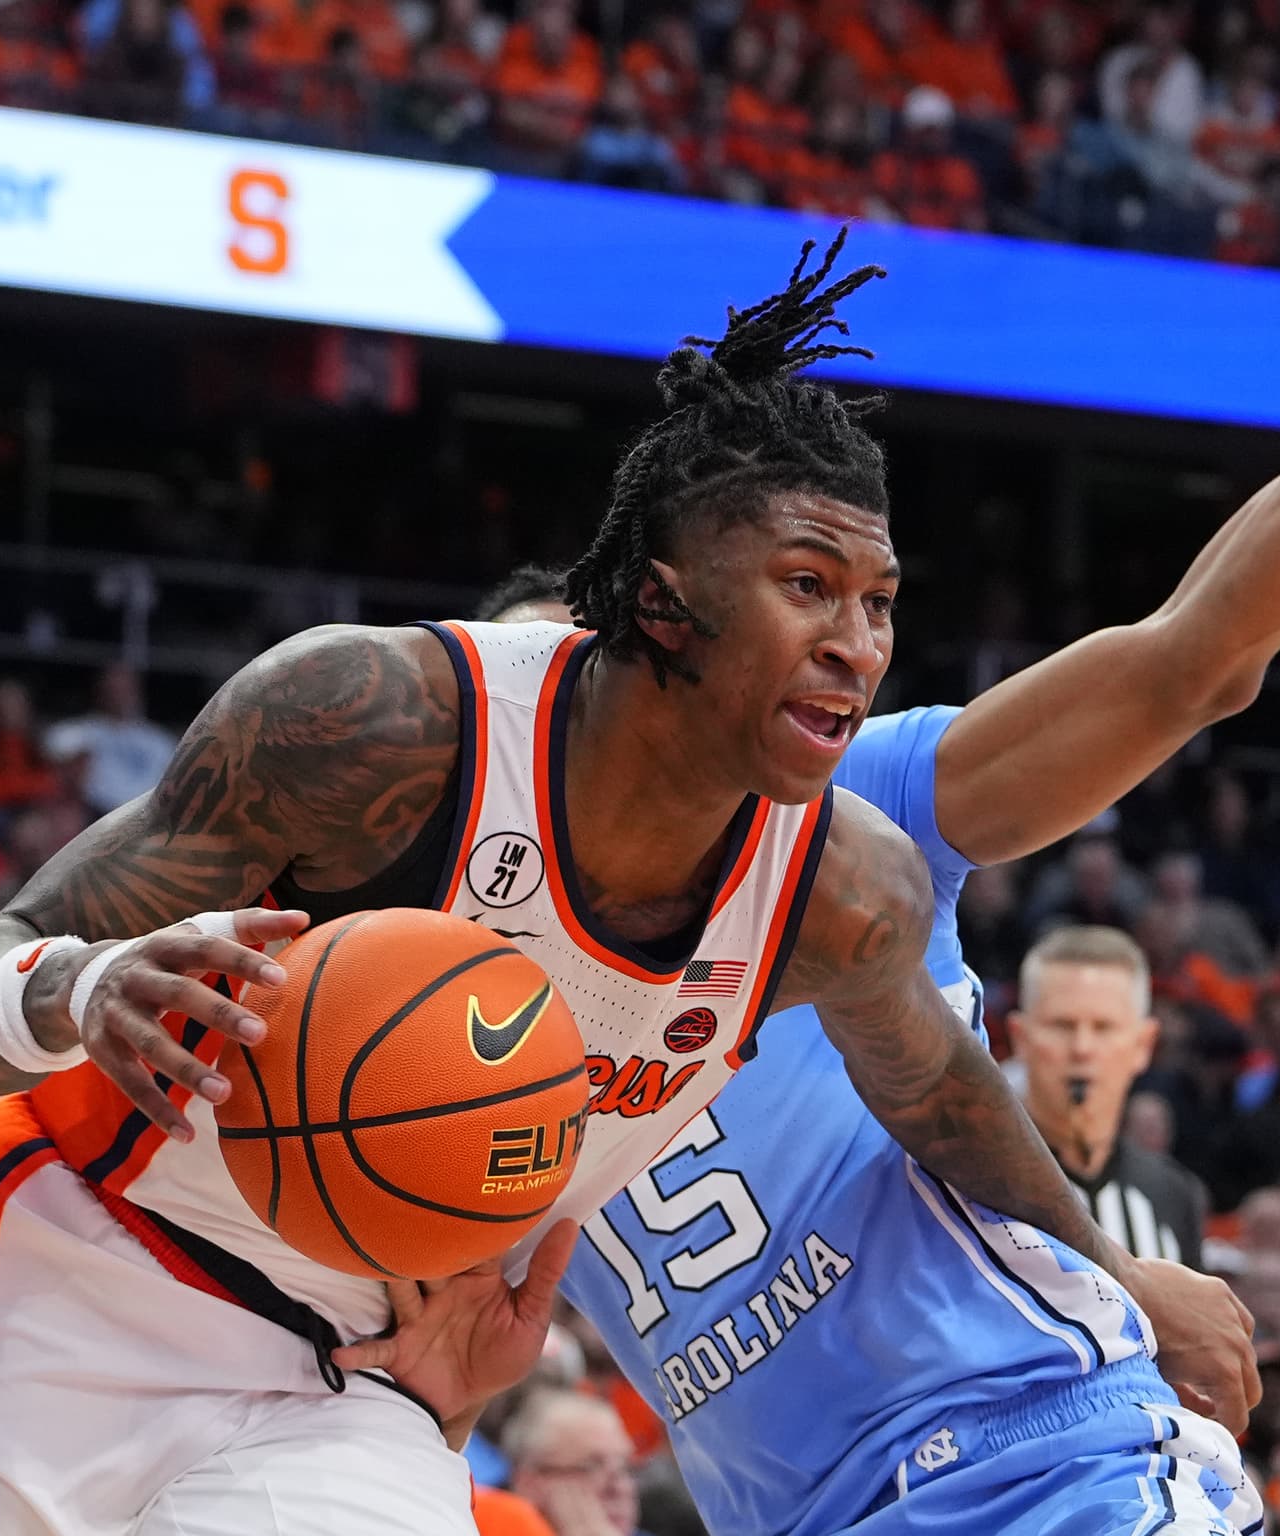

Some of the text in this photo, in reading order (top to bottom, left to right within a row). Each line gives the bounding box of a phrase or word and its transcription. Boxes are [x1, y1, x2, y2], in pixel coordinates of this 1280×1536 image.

[228, 168, 290, 276] S
[485, 866, 518, 900] 21
[498, 841, 528, 868] LM
[673, 1022, 714, 1034] ACC
[580, 1107, 771, 1339] 15
[654, 1231, 854, 1424] AROLINA
